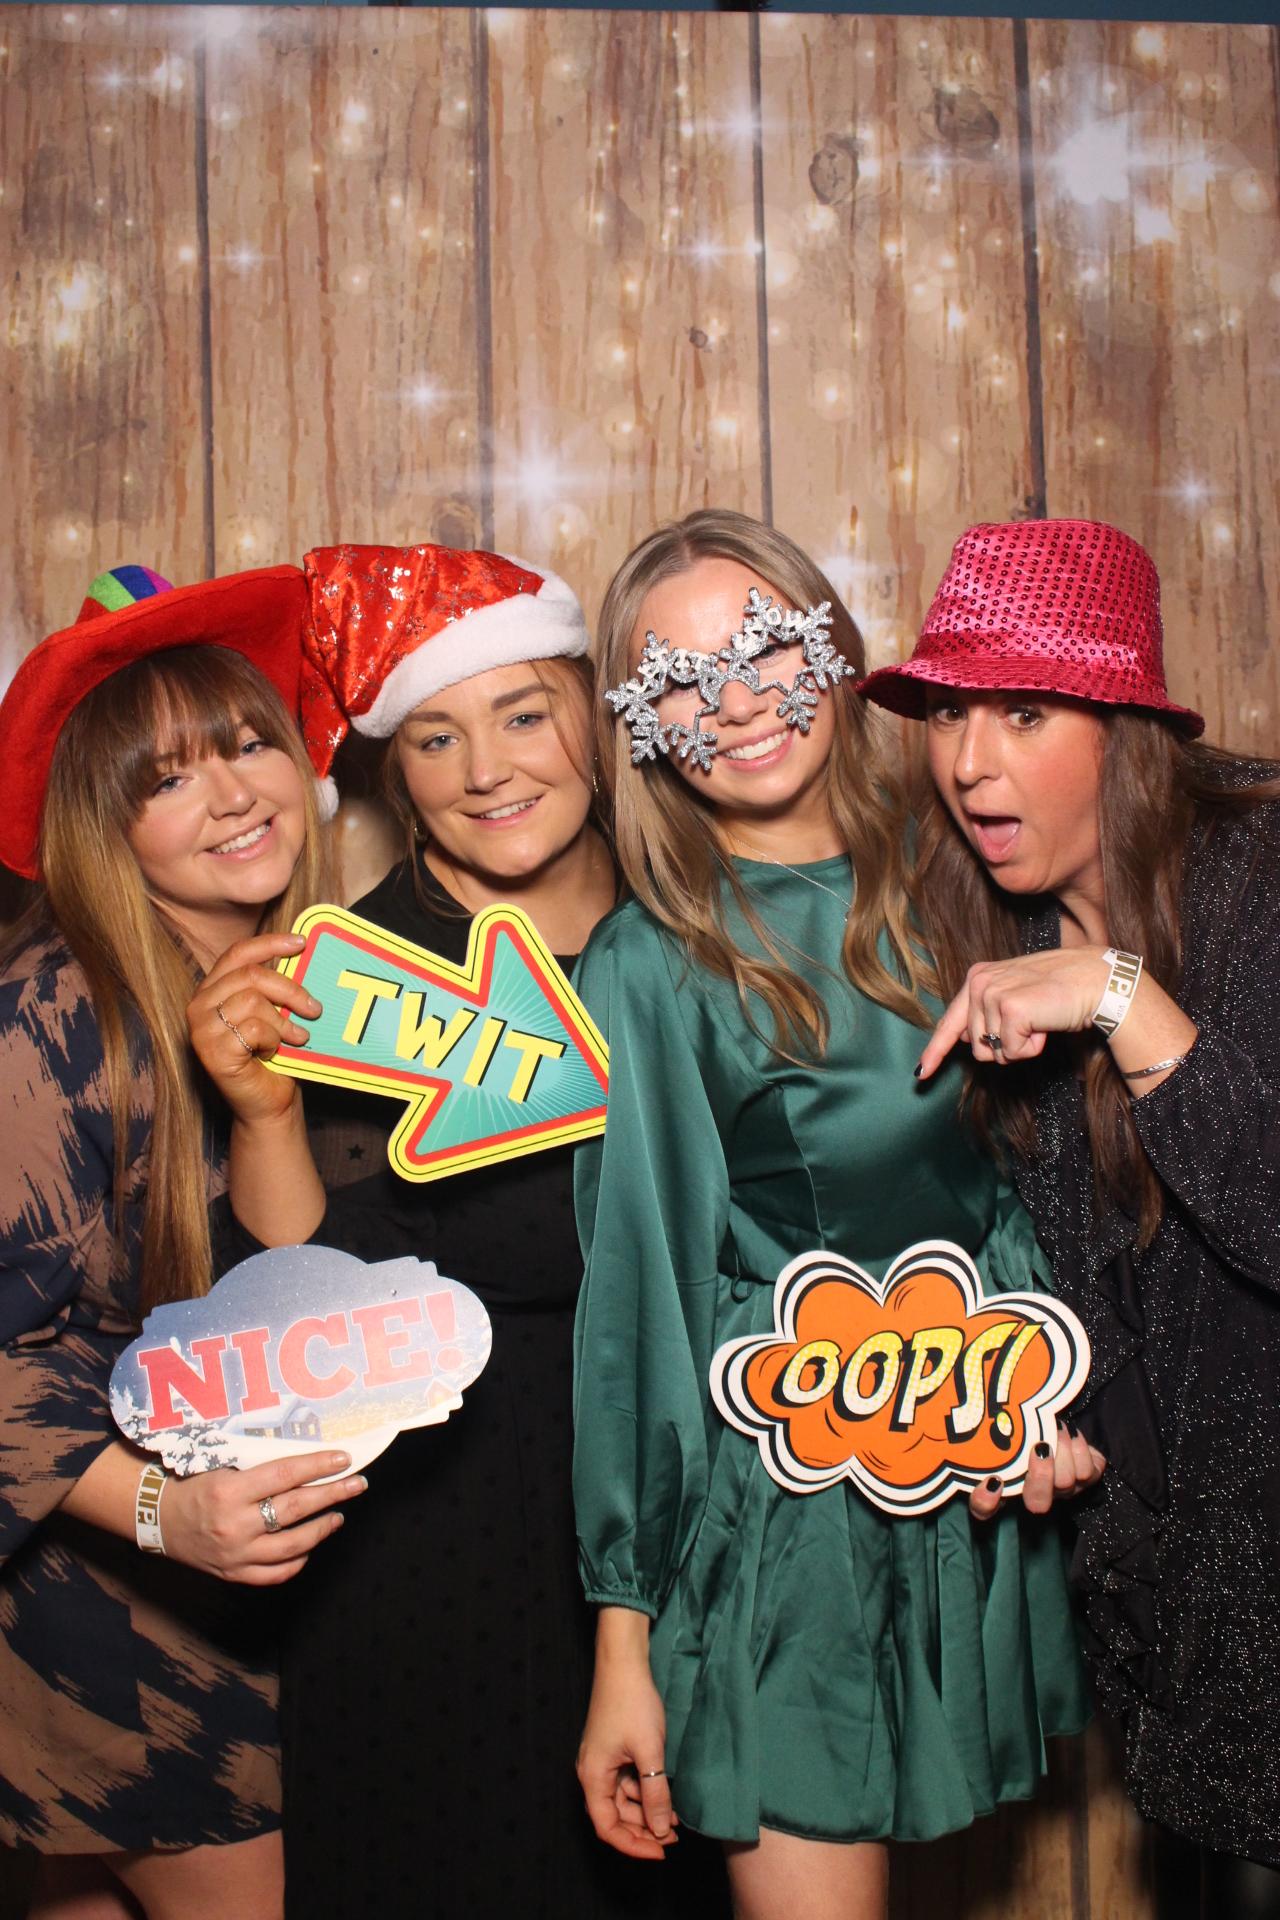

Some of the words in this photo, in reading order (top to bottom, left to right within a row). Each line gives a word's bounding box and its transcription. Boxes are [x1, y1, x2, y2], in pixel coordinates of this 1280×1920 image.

[336, 968, 568, 1105] TWIT
[136, 1290, 465, 1432] NICE!
[771, 1319, 1048, 1450] OOPS!
